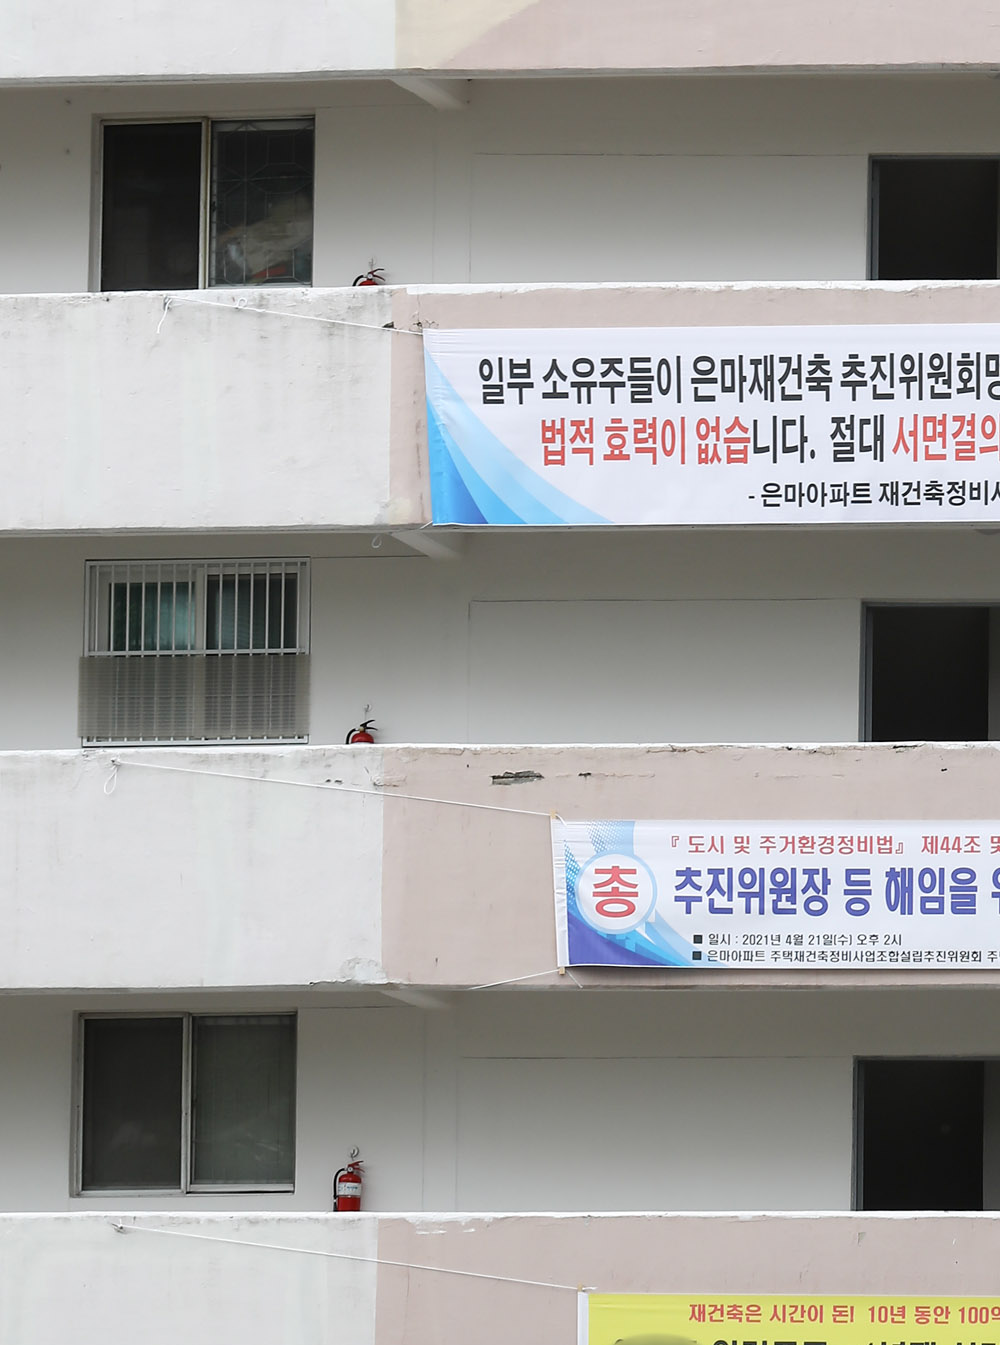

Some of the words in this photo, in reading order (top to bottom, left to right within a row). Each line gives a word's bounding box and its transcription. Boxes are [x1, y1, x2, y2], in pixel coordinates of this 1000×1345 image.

[479, 357, 534, 404] 일부
[542, 356, 681, 404] 소유주들이
[691, 354, 832, 403] 은마재건축
[542, 418, 593, 466] 법적
[603, 417, 685, 465] 효력이
[696, 415, 815, 464] 없습니다.
[830, 414, 884, 462] 절대
[761, 482, 872, 507] 은마아파트
[734, 836, 750, 854] 및
[760, 836, 903, 854] 주거환경정비법』
[921, 836, 980, 854] 제44조
[593, 866, 638, 918] 총
[674, 867, 831, 916] 추진위원장
[844, 869, 872, 916] 등
[885, 867, 977, 915] 해임을
[709, 934, 730, 945] 일시
[743, 934, 780, 946] 2021년
[786, 934, 803, 945] 4월
[809, 934, 852, 946] 21일(수)
[857, 934, 879, 945] 오후
[884, 934, 901, 945] 2시
[707, 950, 765, 962] 은마아파트
[771, 951, 981, 962] 주택재건축정비사업조합설립추진위원회
[689, 1304, 762, 1322] 재건축은
[770, 1305, 823, 1323] 시간이
[832, 1305, 854, 1323] 돈!
[869, 1306, 905, 1323] 10년
[915, 1306, 950, 1324] 동안
